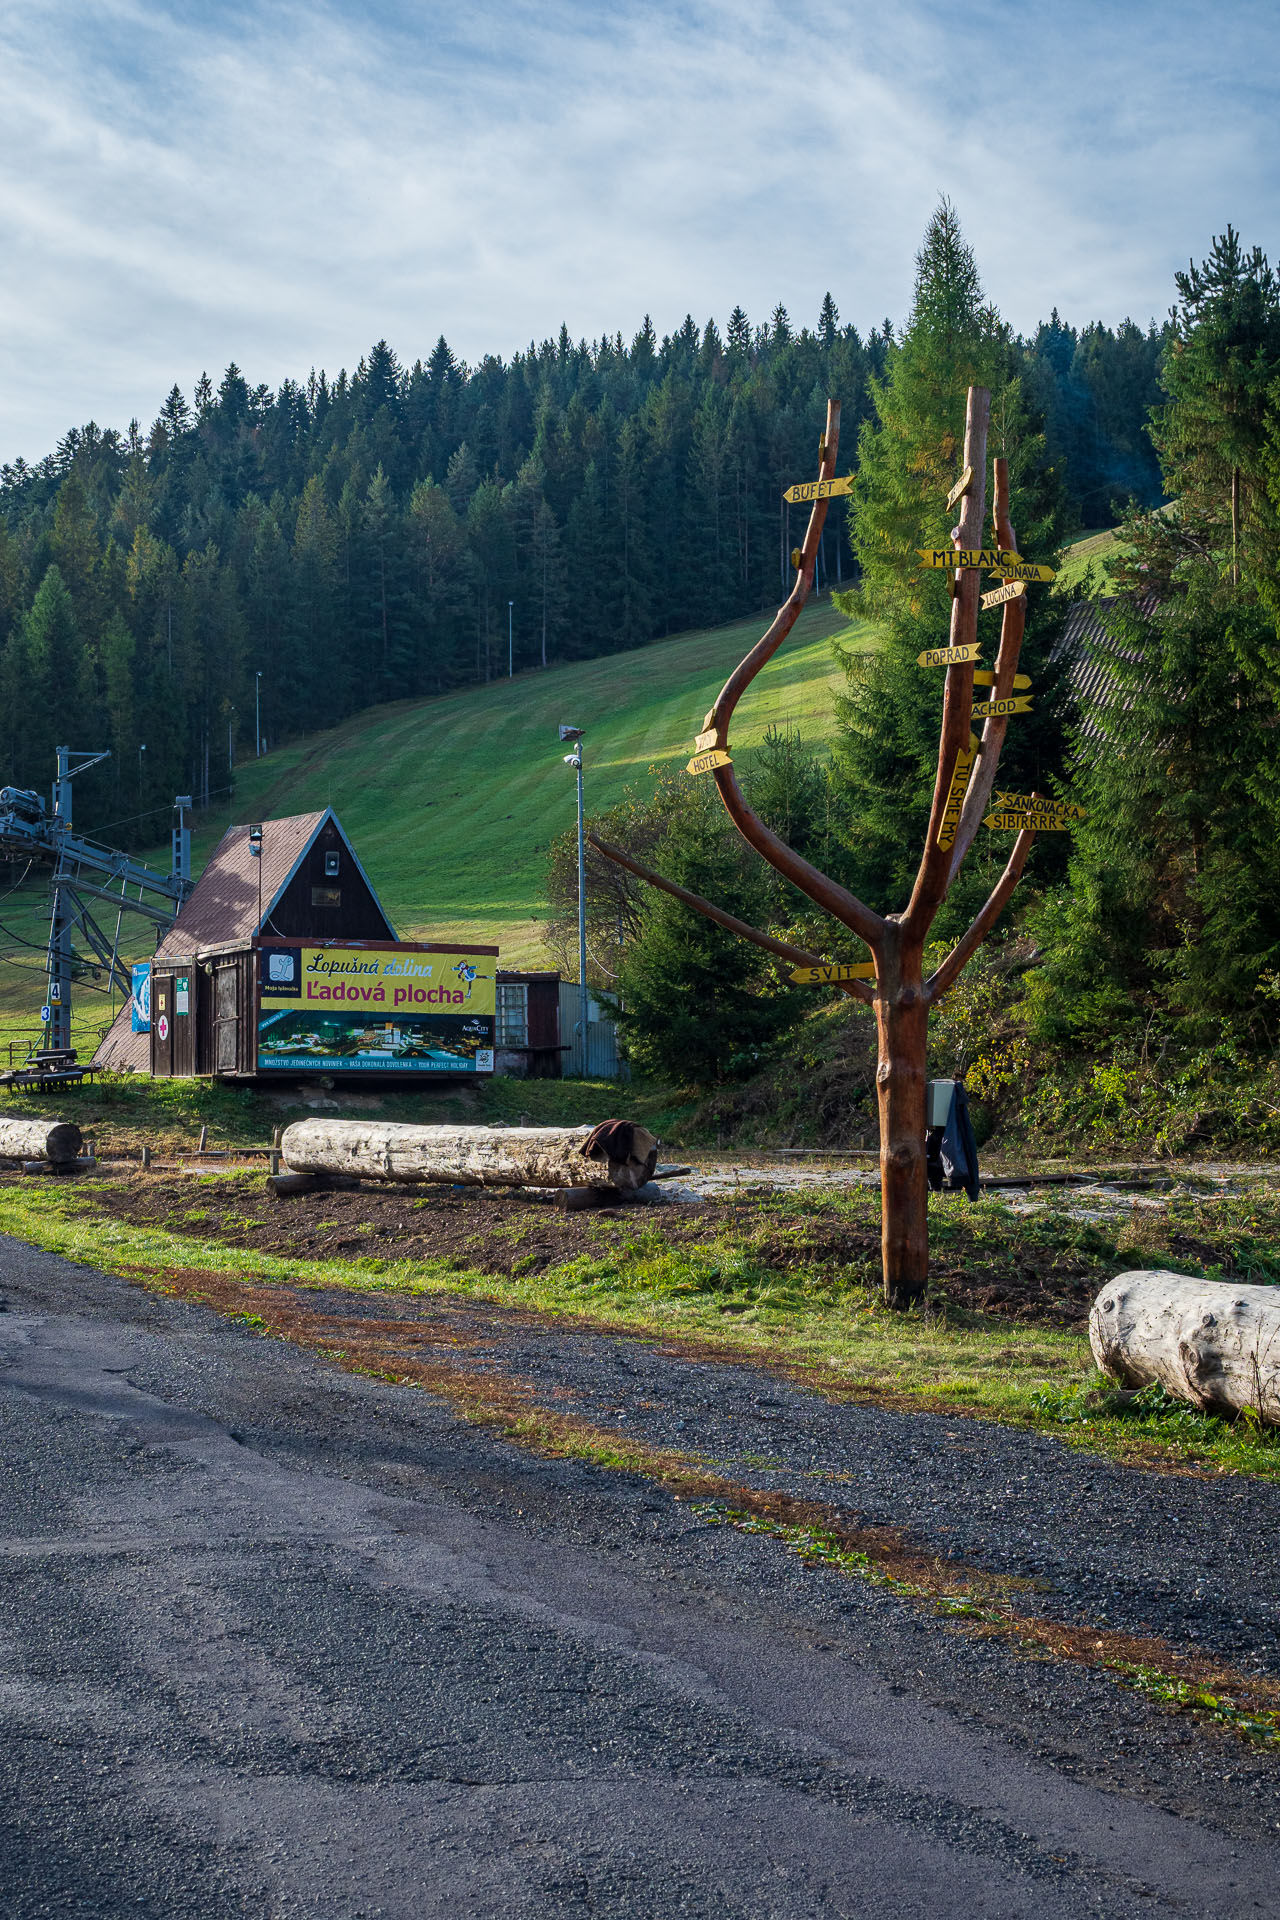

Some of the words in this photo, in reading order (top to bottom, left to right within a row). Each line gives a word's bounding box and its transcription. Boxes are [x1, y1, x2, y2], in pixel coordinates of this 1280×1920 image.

[792, 481, 835, 501] BUFET
[926, 646, 970, 666] POPRAD
[970, 700, 1016, 716] ÁCHOD
[693, 753, 720, 773] HOTEL
[955, 763, 970, 781] TU
[946, 787, 964, 816] SME
[939, 821, 957, 843] MY
[306, 953, 379, 979] Lopušná
[382, 958, 433, 977] dolina
[808, 965, 854, 981] SVIT
[51, 985, 60, 999] 4
[306, 981, 386, 1001] Ľadová
[393, 984, 465, 1007] plocha
[41, 1007, 50, 1021] 3
